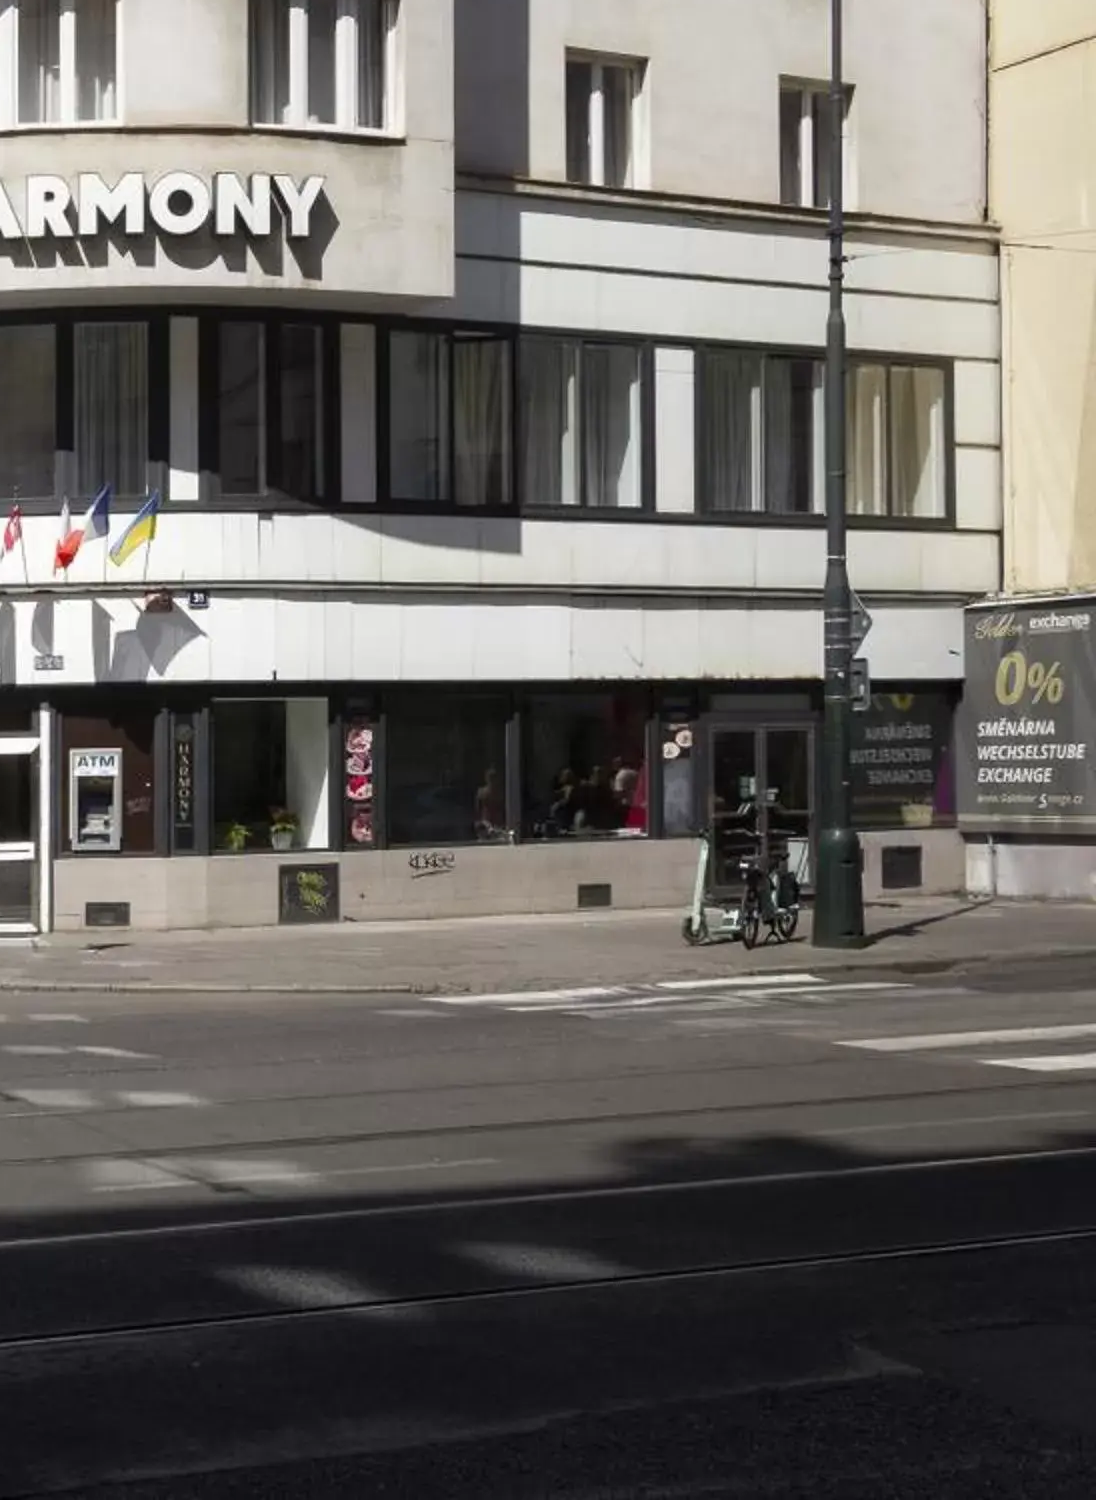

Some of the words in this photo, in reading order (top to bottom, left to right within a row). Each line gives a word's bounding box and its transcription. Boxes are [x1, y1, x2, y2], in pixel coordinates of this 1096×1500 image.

[995, 650, 1063, 705] 0%
[976, 717, 1056, 737] SMĚNÁRNA
[78, 754, 116, 768] ATM
[977, 743, 1086, 761] WECHSELSTUBE
[977, 767, 1053, 784] EXCHANGE
